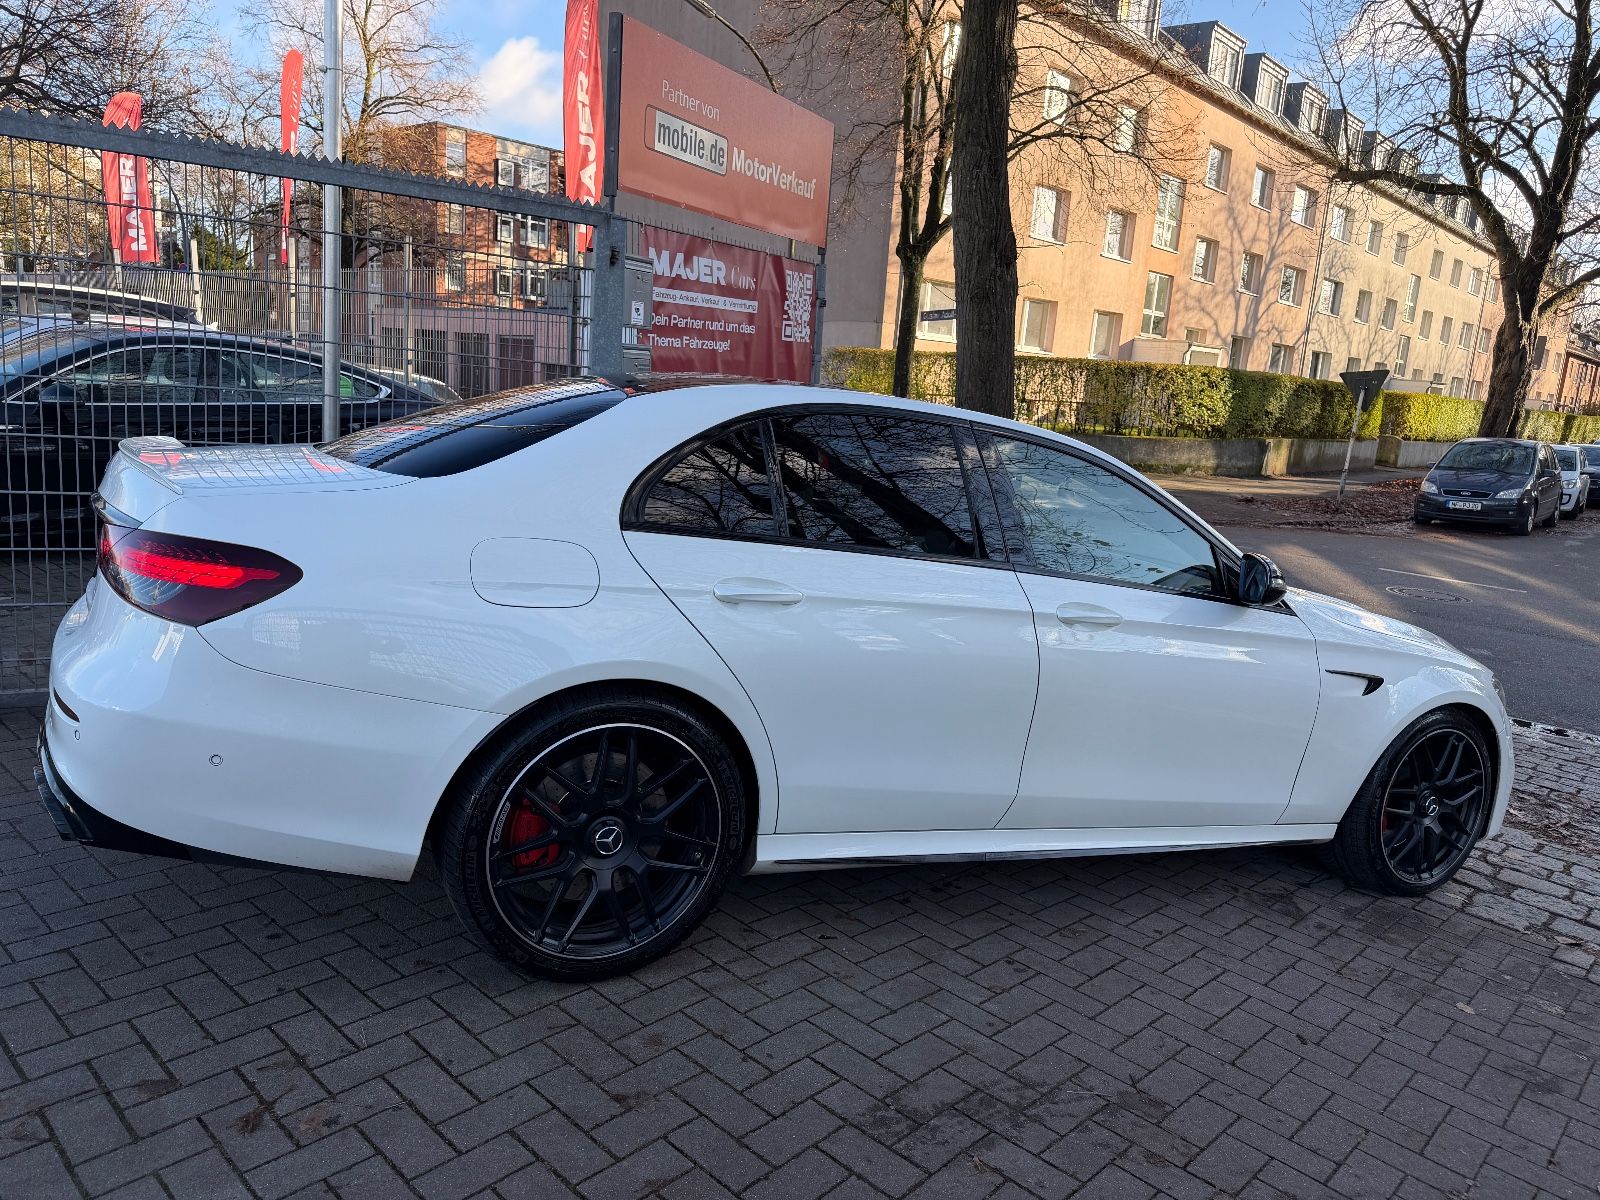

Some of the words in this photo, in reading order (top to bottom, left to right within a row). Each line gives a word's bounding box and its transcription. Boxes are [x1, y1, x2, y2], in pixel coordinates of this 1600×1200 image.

[662, 79, 700, 111] Partner
[701, 101, 720, 122] von
[657, 121, 725, 167] mobile.de
[731, 147, 817, 200] MotorVerkauf
[649, 247, 727, 286] MAJER
[647, 334, 682, 348] Thema
[682, 336, 731, 353] Fahrzeuge!
[671, 315, 705, 330] Partner
[706, 320, 725, 331] rund
[726, 324, 739, 333] um
[739, 322, 756, 334] das
